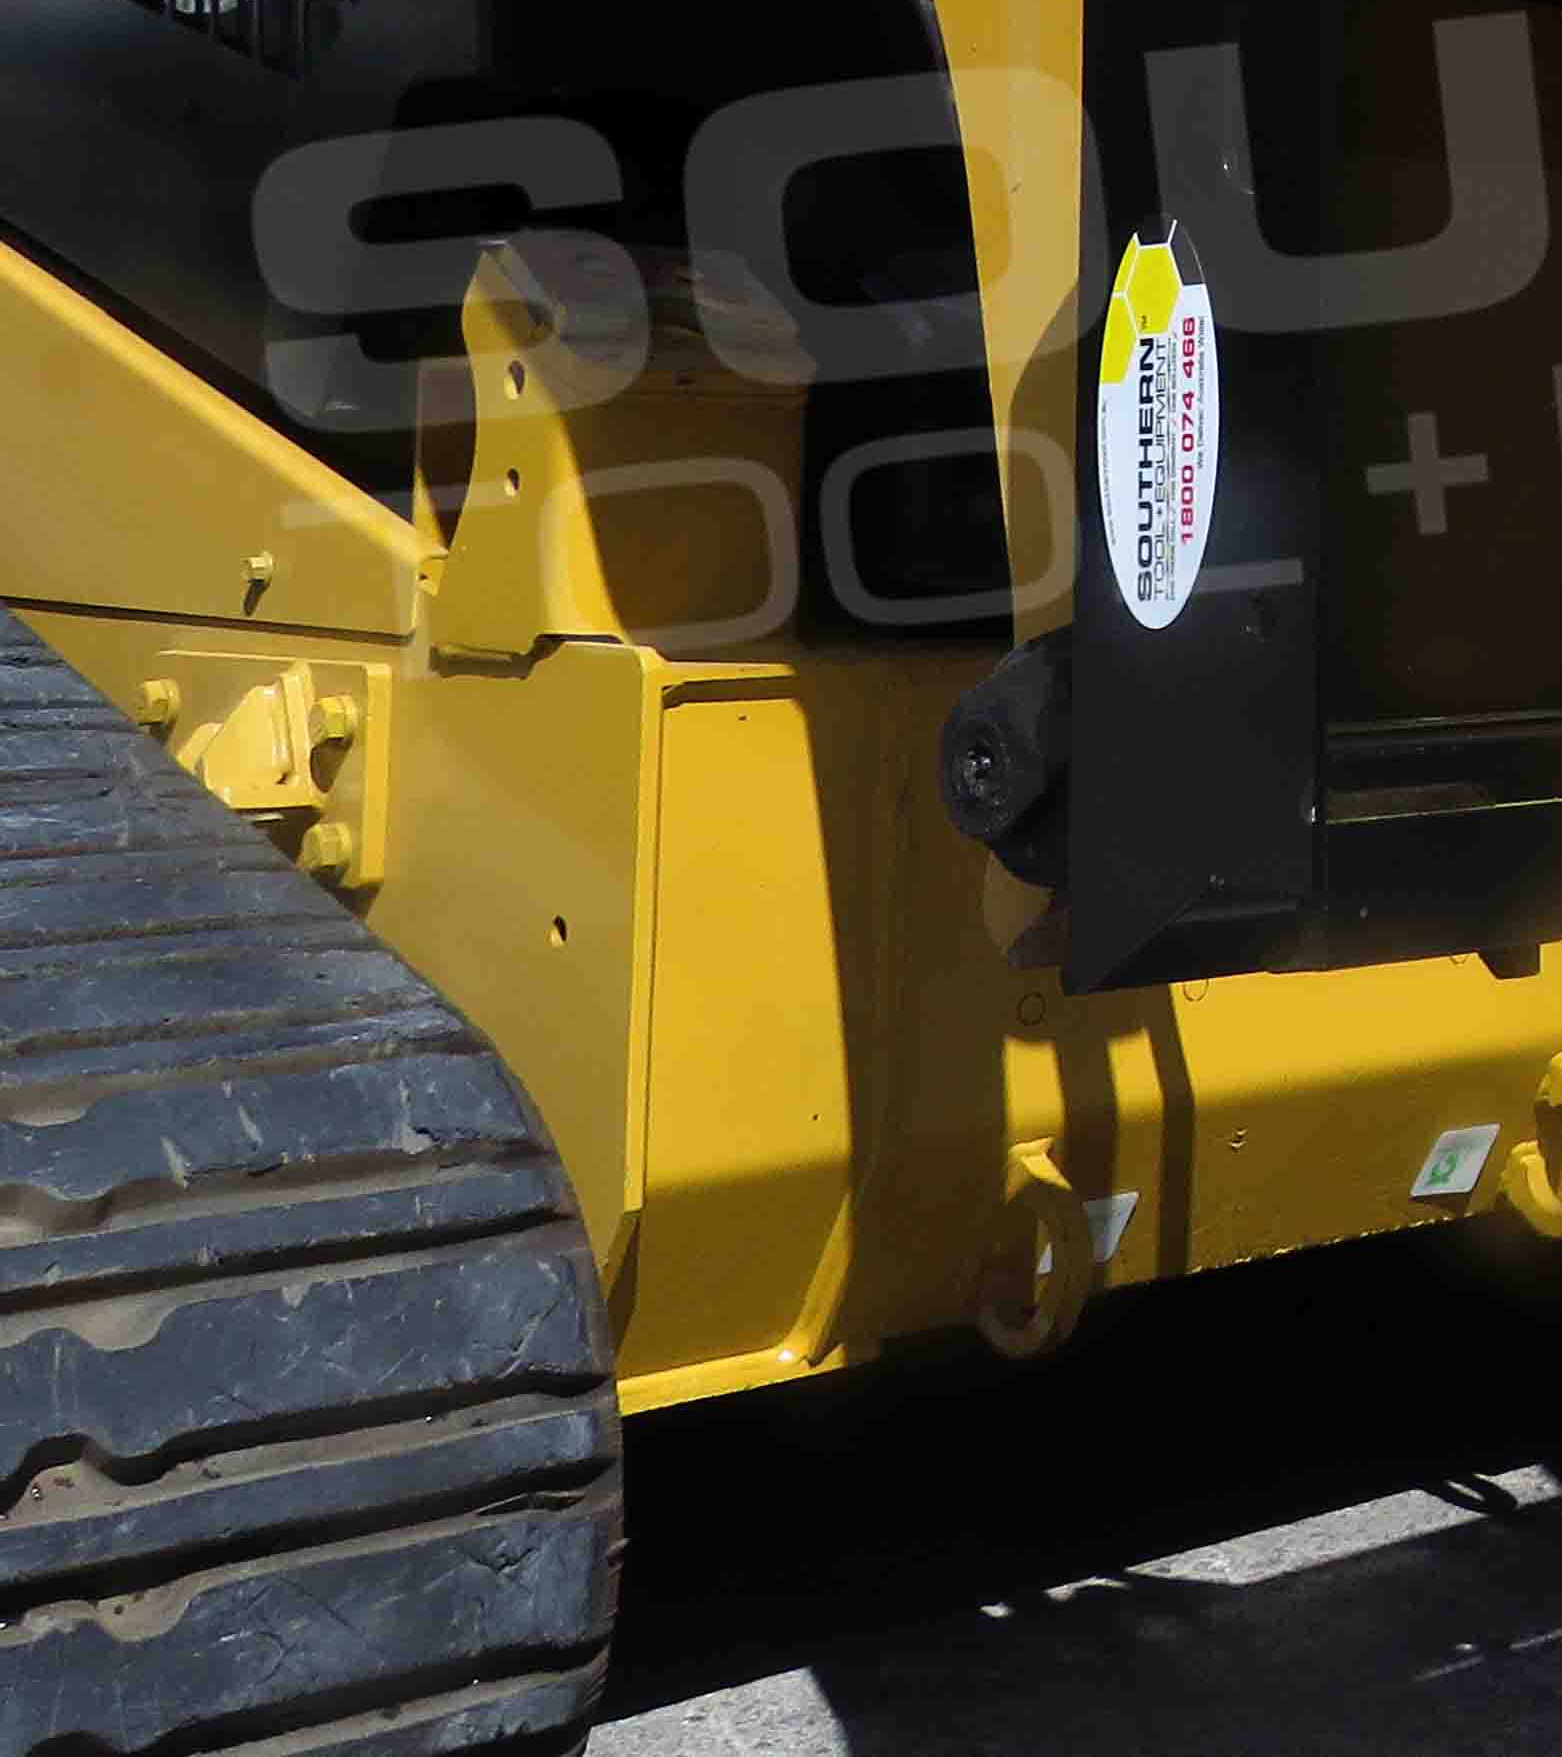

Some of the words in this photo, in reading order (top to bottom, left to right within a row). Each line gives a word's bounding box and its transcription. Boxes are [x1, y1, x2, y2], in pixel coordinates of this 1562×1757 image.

[1182, 316, 1196, 378] 466
[1155, 338, 1166, 503] EQUIPMENT
[1181, 391, 1195, 453] 074
[1137, 338, 1154, 601] SOUTHERN
[1180, 465, 1194, 546] 1800
[1154, 520, 1166, 600] TOOL
